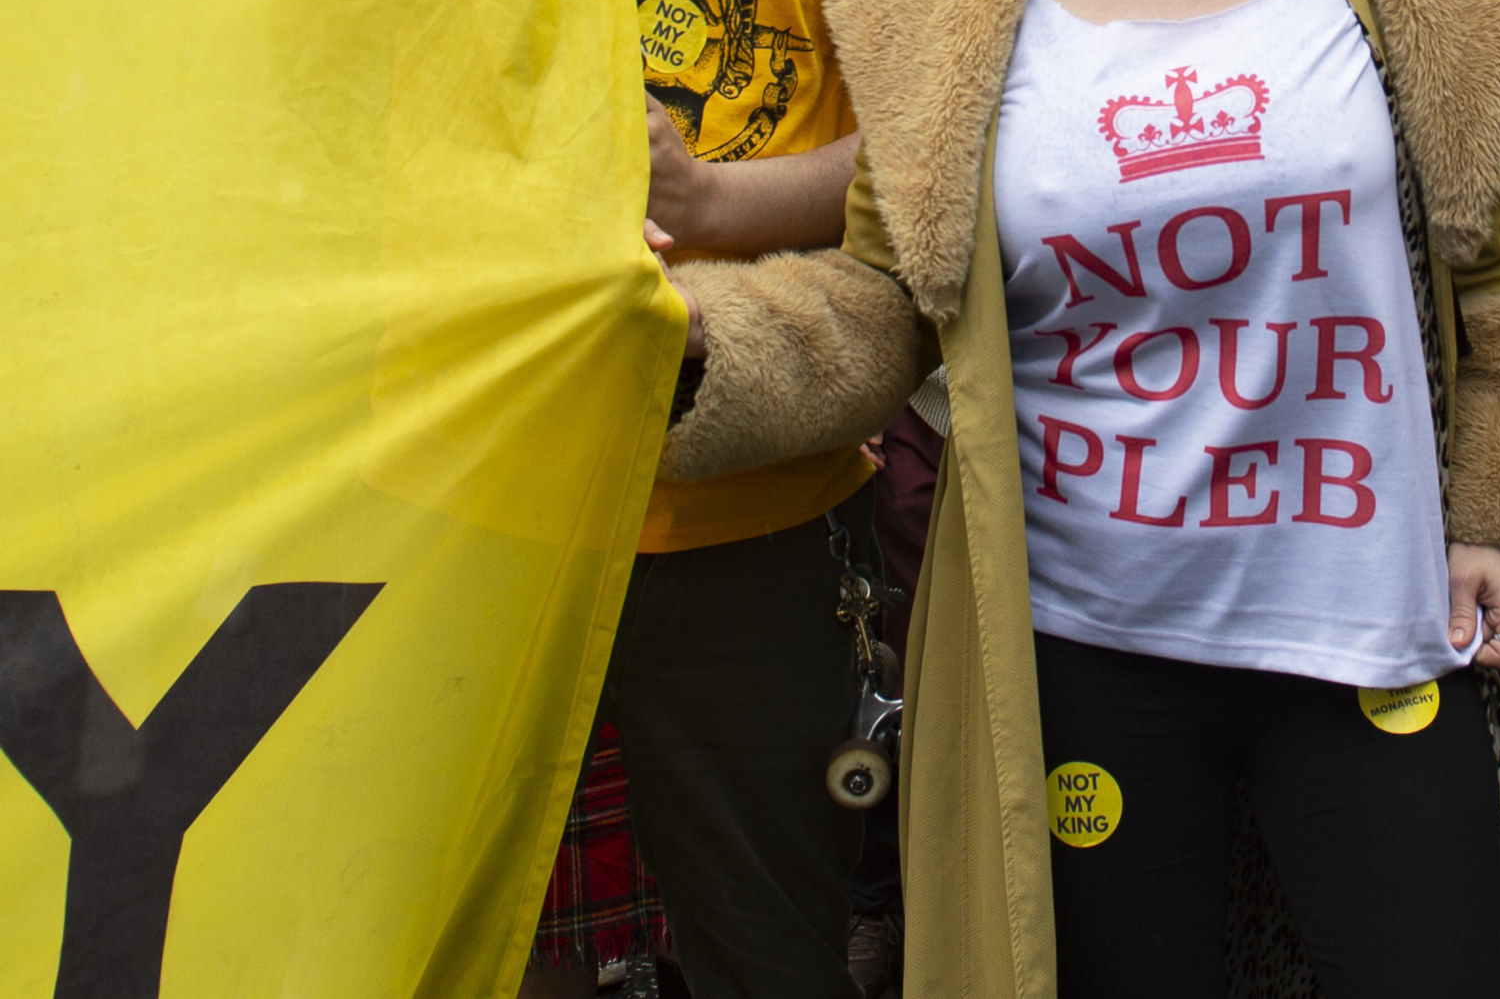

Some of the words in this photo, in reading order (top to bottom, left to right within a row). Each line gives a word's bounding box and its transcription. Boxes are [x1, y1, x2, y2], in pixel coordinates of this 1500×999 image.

[655, 0, 699, 28] NOT
[652, 20, 685, 43] MY
[640, 34, 684, 67] KING
[1041, 189, 1351, 309] NOT
[1034, 315, 1394, 410] YOUR
[1036, 414, 1377, 529] PLEB
[1370, 693, 1434, 718] MONARCHY
[1057, 772, 1100, 792] NOT
[1065, 794, 1096, 813] MY
[1057, 815, 1110, 834] KING
